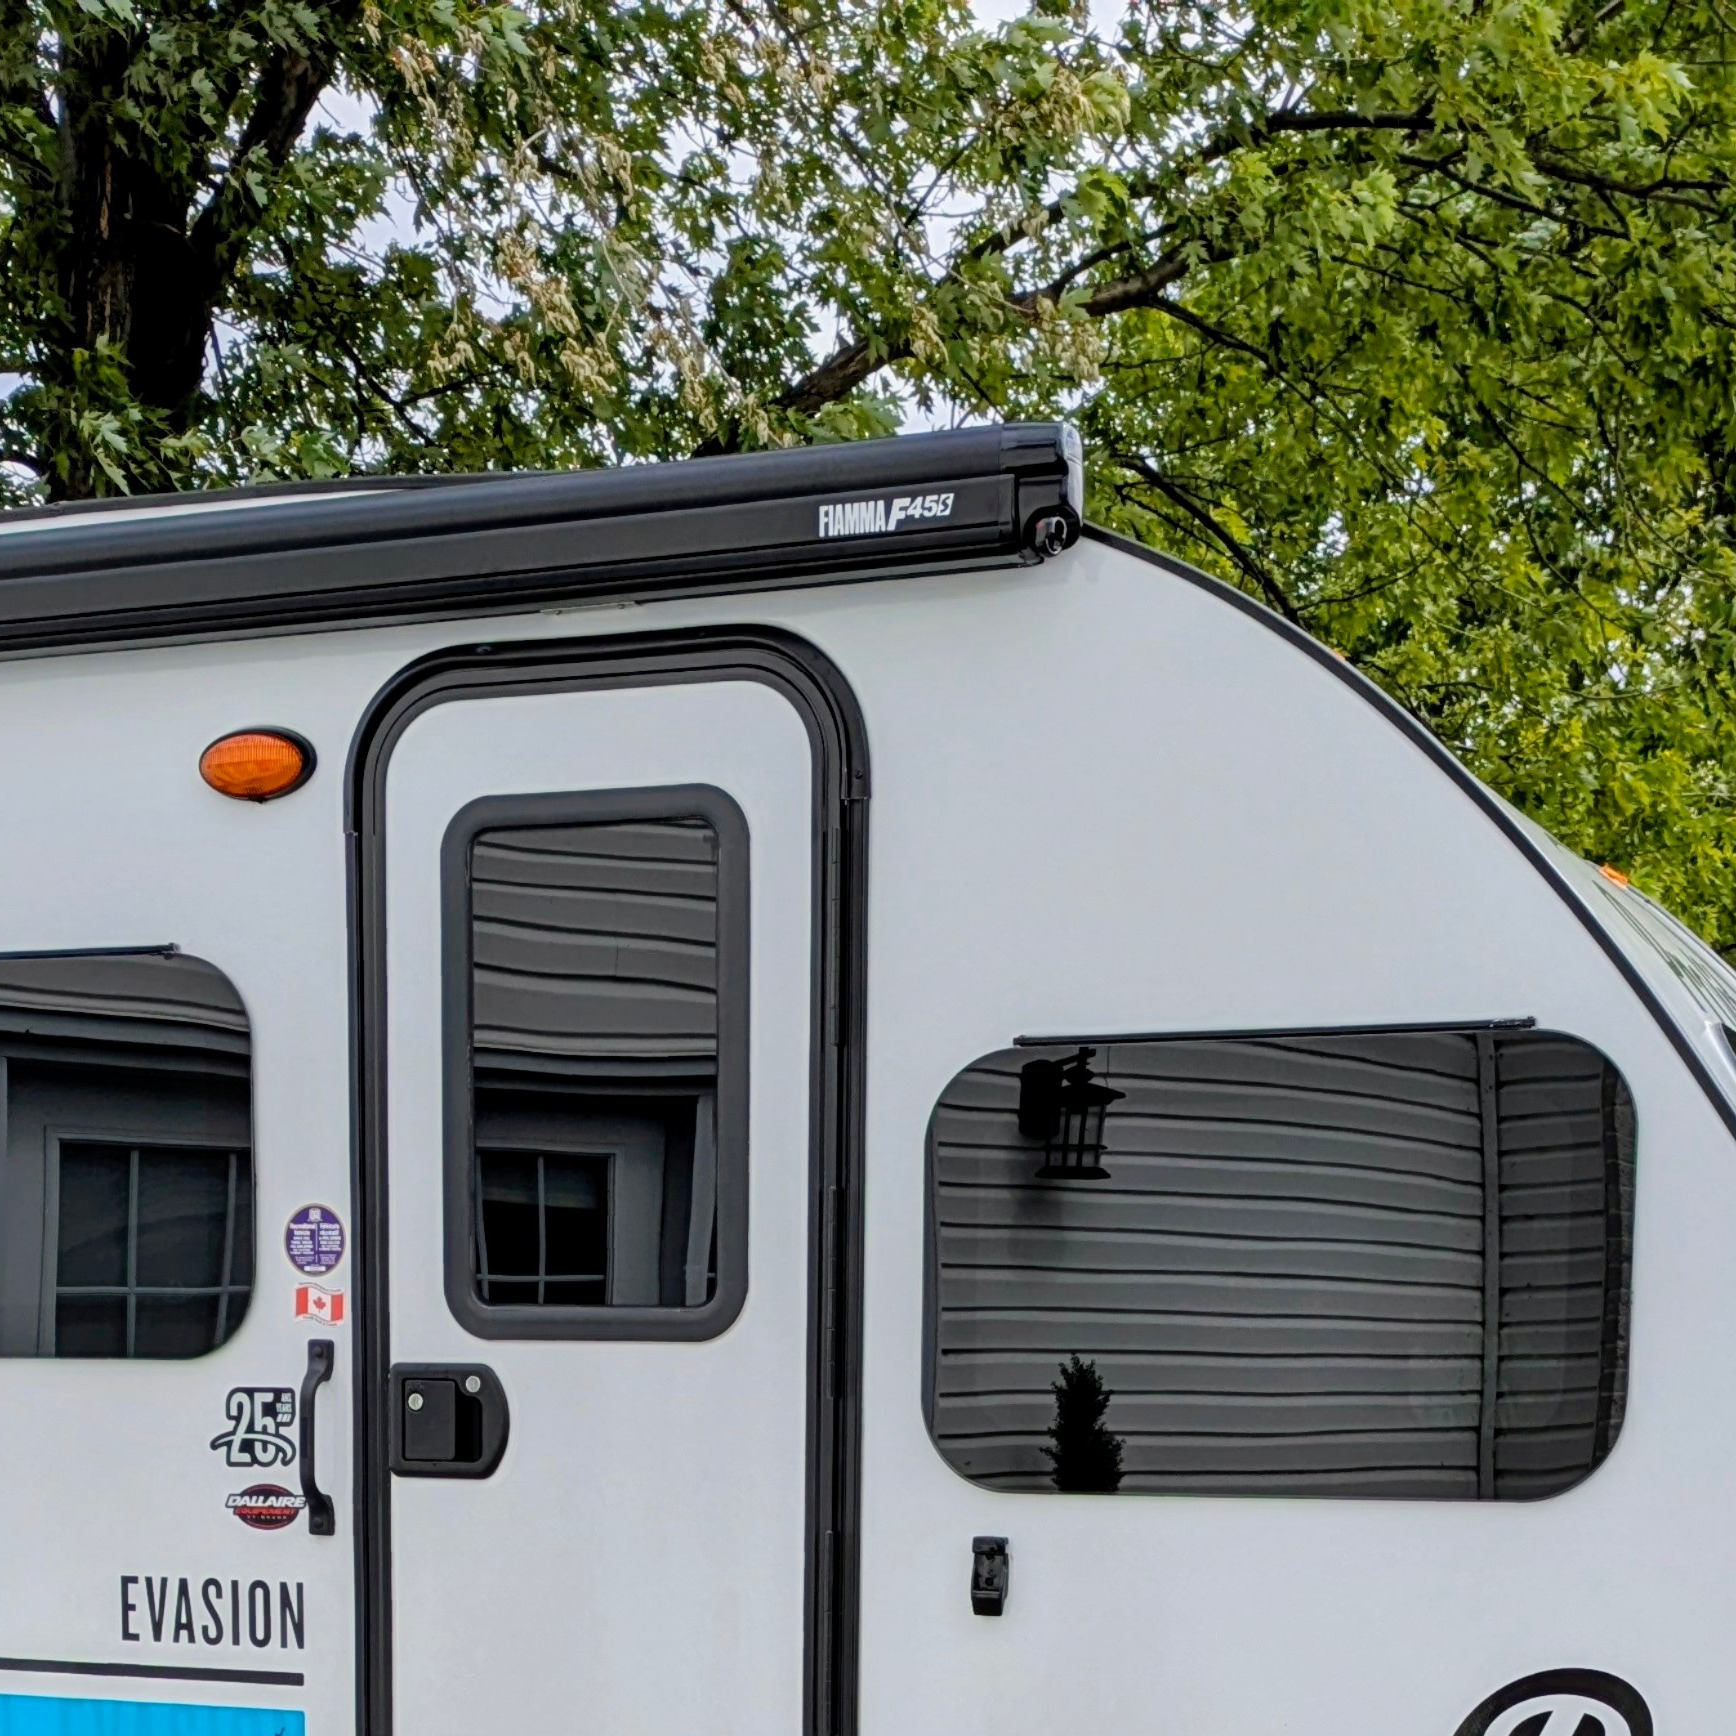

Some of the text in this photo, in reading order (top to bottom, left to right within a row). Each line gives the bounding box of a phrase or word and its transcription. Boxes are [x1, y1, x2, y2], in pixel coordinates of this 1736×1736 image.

[818, 500, 887, 538] FIAMMA
[229, 1391, 276, 1463] 25
[227, 1495, 306, 1508] DALLAIRE
[120, 1575, 305, 1649] EVASION
